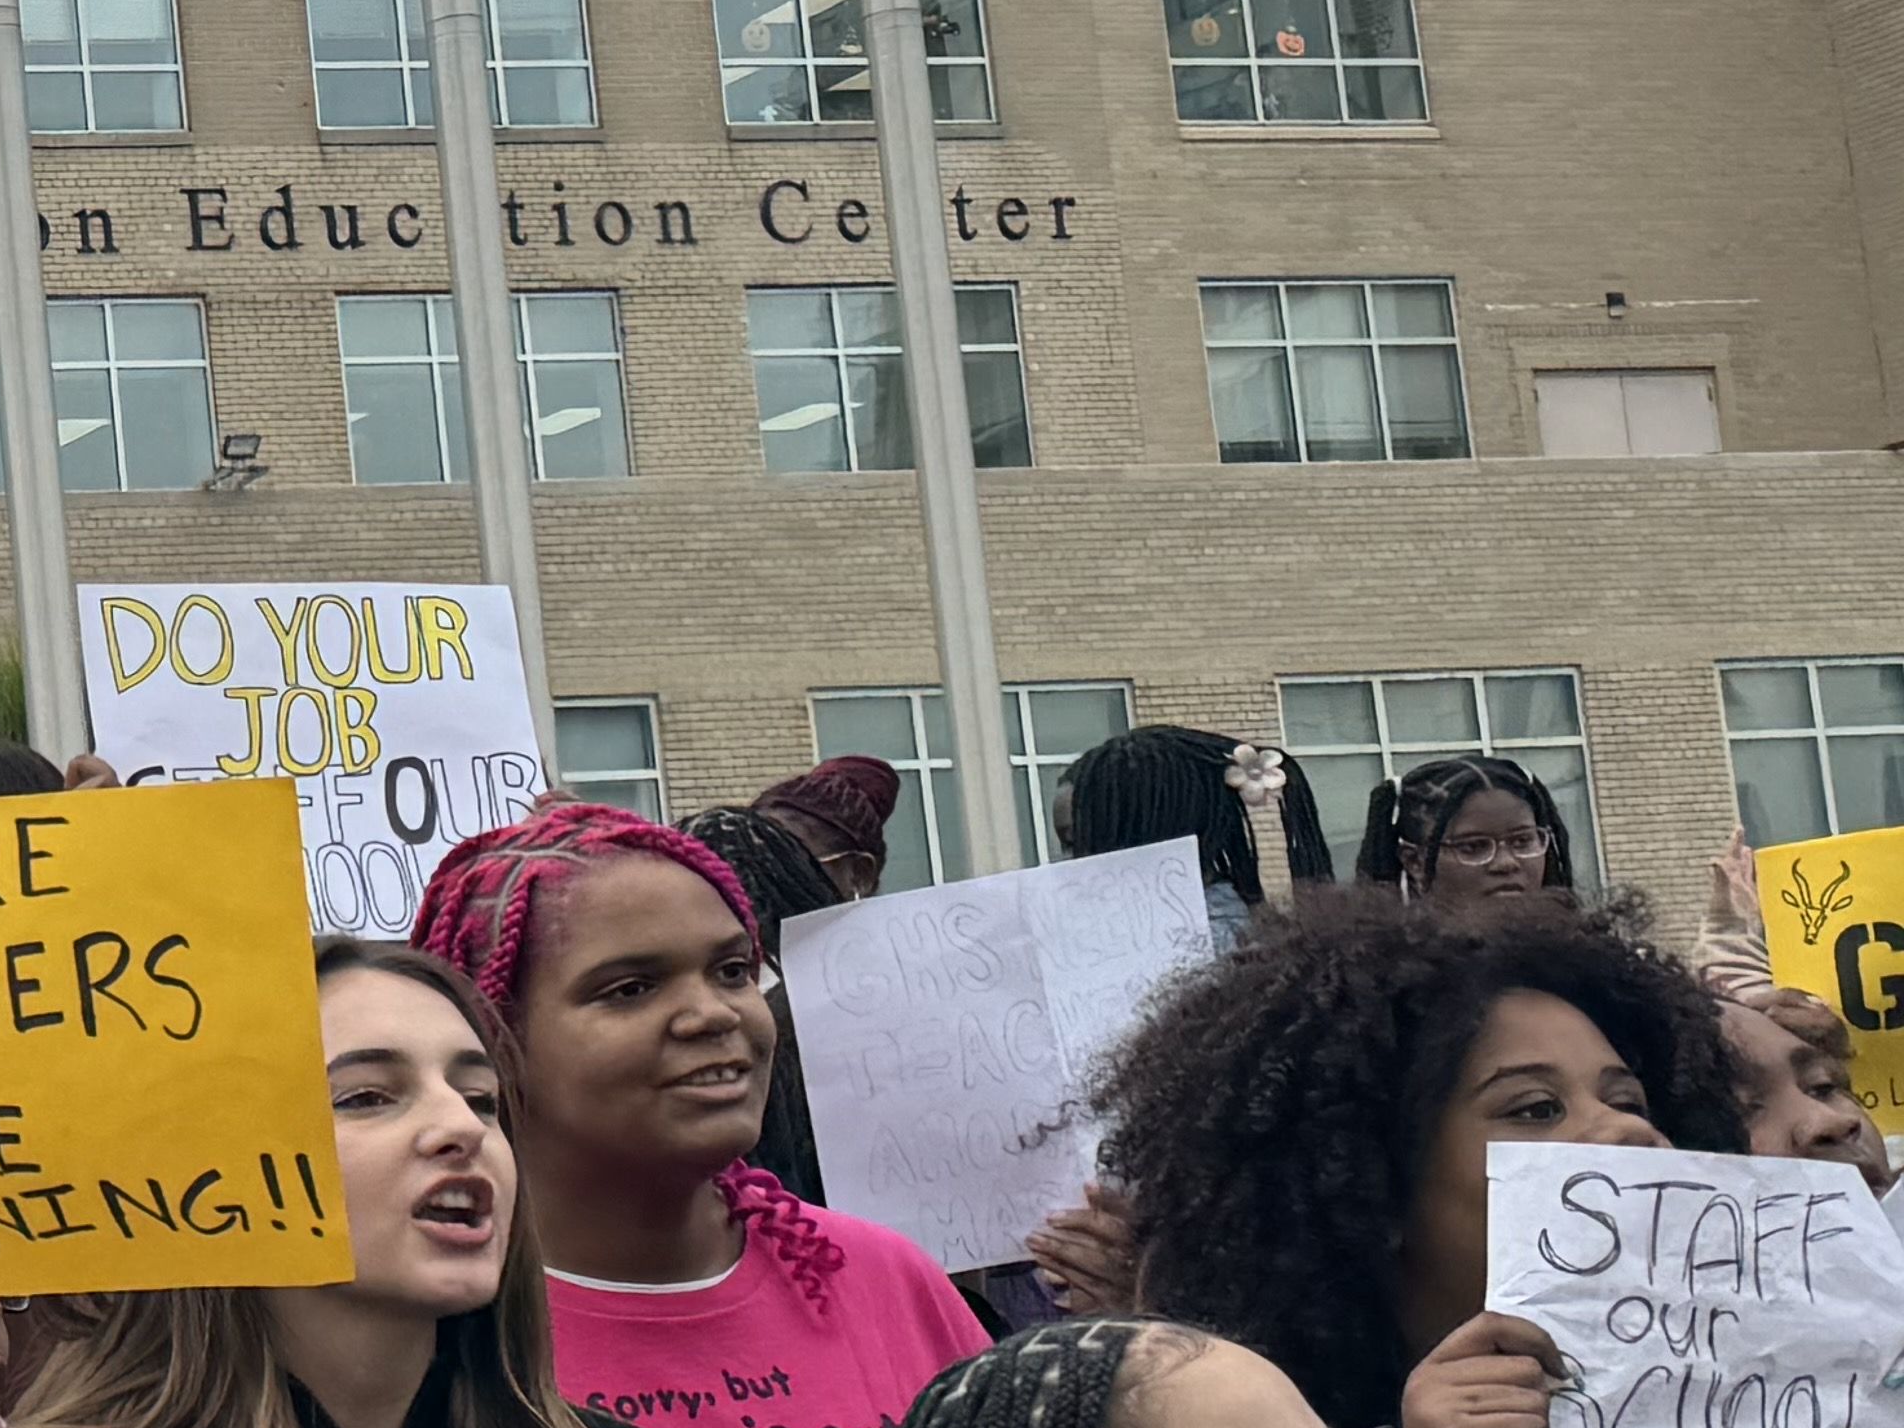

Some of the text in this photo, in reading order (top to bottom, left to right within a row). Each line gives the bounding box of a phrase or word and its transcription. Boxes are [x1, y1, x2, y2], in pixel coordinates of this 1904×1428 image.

[180, 181, 699, 254] Eduction
[761, 179, 1078, 245] Ceter
[100, 594, 475, 694] DO YOUR
[215, 686, 381, 776] JOB
[384, 752, 542, 846] OUR
[1538, 1171, 1855, 1303] STAFF
[721, 1366, 792, 1402] but
